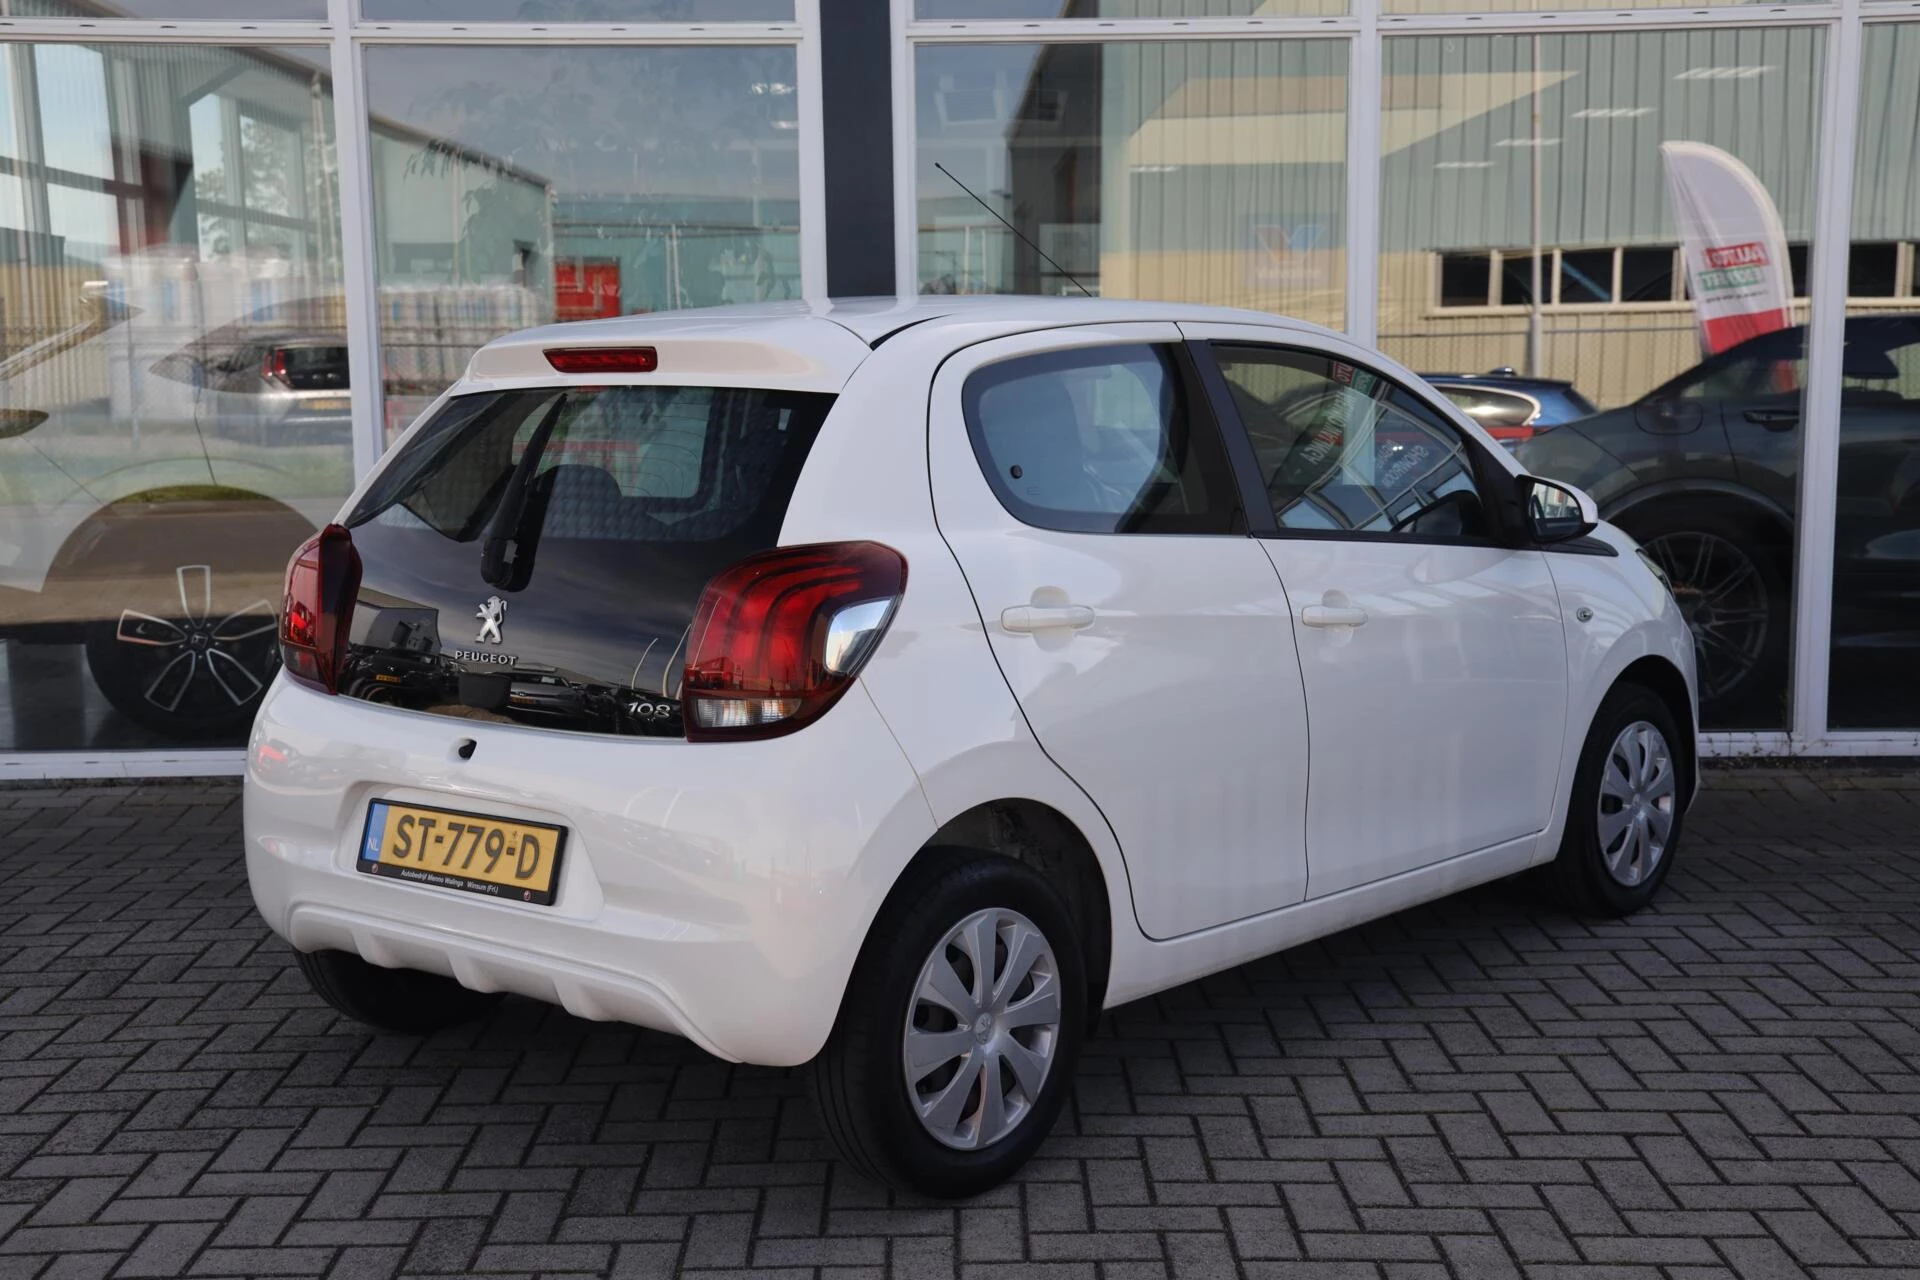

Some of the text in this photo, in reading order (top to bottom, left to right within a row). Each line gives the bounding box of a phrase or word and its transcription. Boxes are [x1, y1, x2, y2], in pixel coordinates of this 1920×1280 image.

[454, 650, 518, 666] PEUGEOT
[628, 702, 671, 719] 108
[393, 814, 540, 880] ST-779-D
